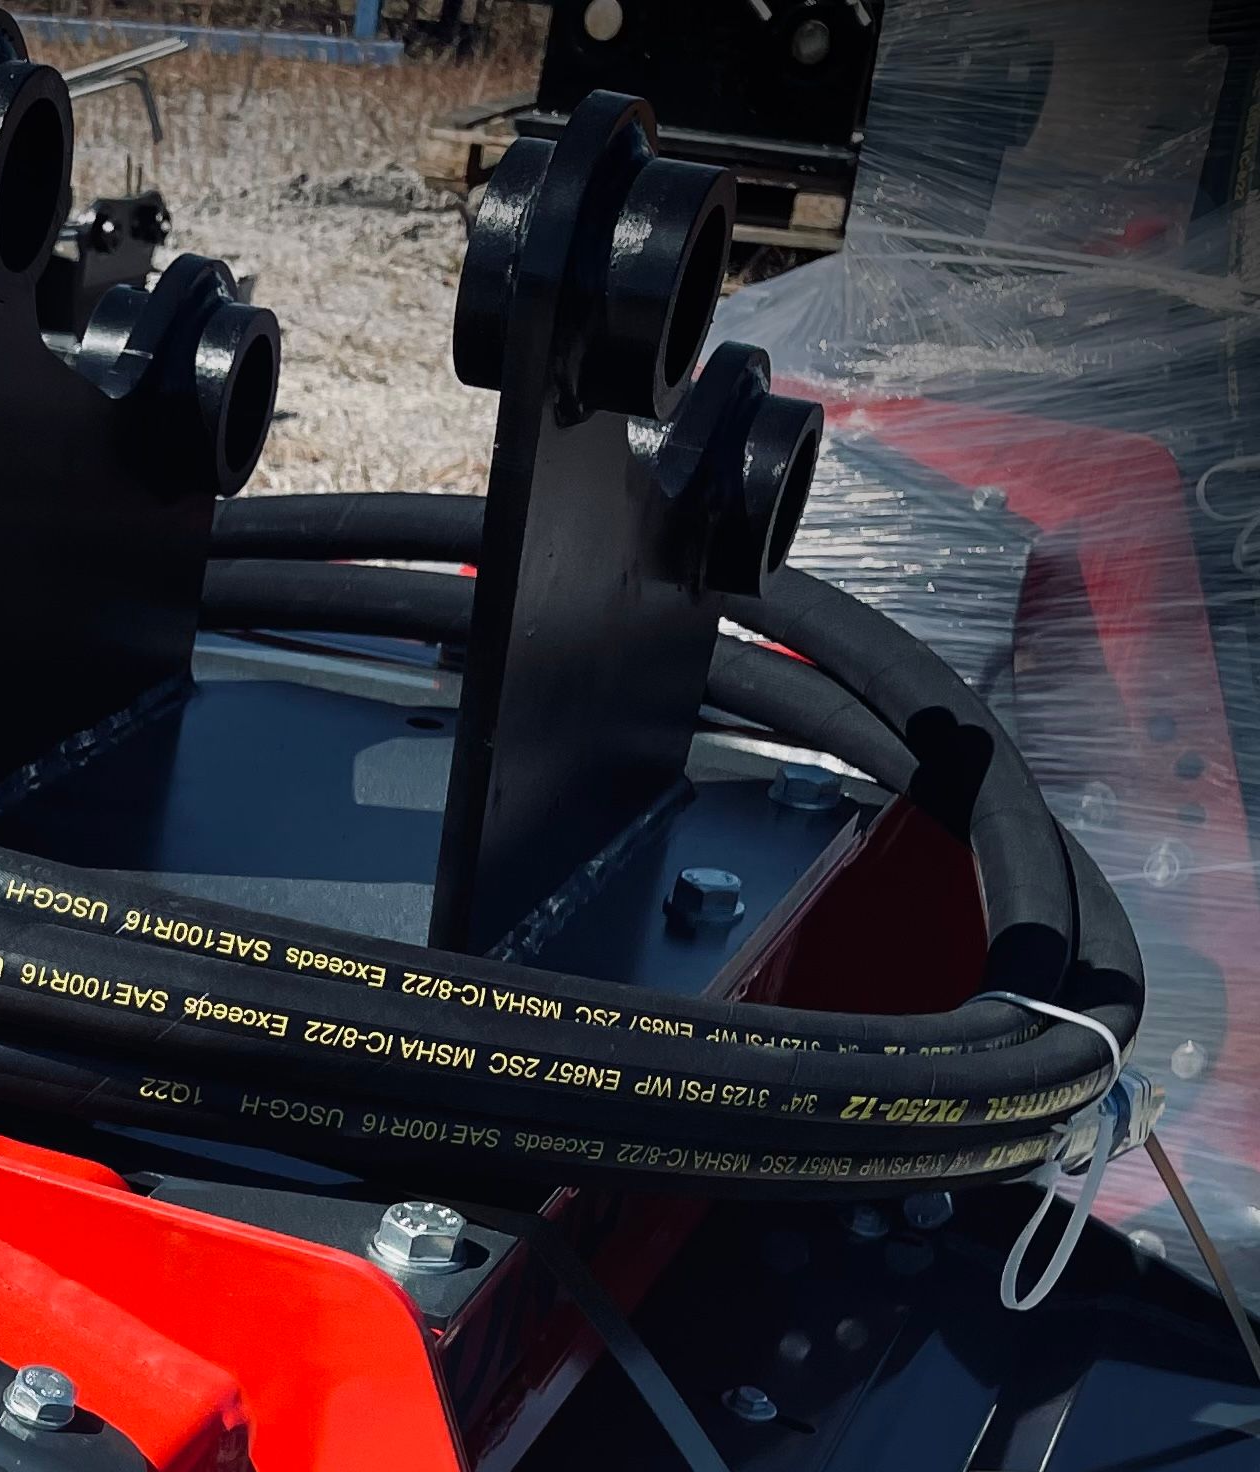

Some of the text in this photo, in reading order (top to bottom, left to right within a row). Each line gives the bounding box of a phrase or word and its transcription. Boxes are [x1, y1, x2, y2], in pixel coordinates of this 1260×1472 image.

[6, 879, 109, 923] USCG-H
[126, 910, 272, 962] SAE100R16
[286, 946, 387, 988] Exceeds
[20, 961, 169, 1013] SAE100R16
[401, 973, 487, 1008] IC-8/22
[184, 995, 290, 1037] Exceeds
[493, 989, 563, 1020] MSHA
[574, 1003, 621, 1029] 2SC
[303, 1019, 393, 1056] IC-8/22
[398, 1036, 477, 1070] MSHA
[490, 1052, 538, 1080] 2SC
[544, 1060, 621, 1092] EN857
[634, 1075, 672, 1099] WP
[678, 1079, 717, 1103] PSI
[140, 1077, 203, 1107] 1Q22
[720, 1084, 770, 1109] 3125
[780, 1093, 818, 1115] 3/4"
[240, 1094, 344, 1129] USCG-H
[840, 1095, 970, 1123] PX250-12
[361, 1113, 501, 1149] SAE100R16
[514, 1131, 605, 1161] Exceeds
[616, 1143, 690, 1169] IC-8/22
[693, 1150, 751, 1172] MSHA
[759, 1154, 797, 1175] 2SC
[799, 1156, 853, 1177] EN857
[859, 1157, 892, 1176] WP
